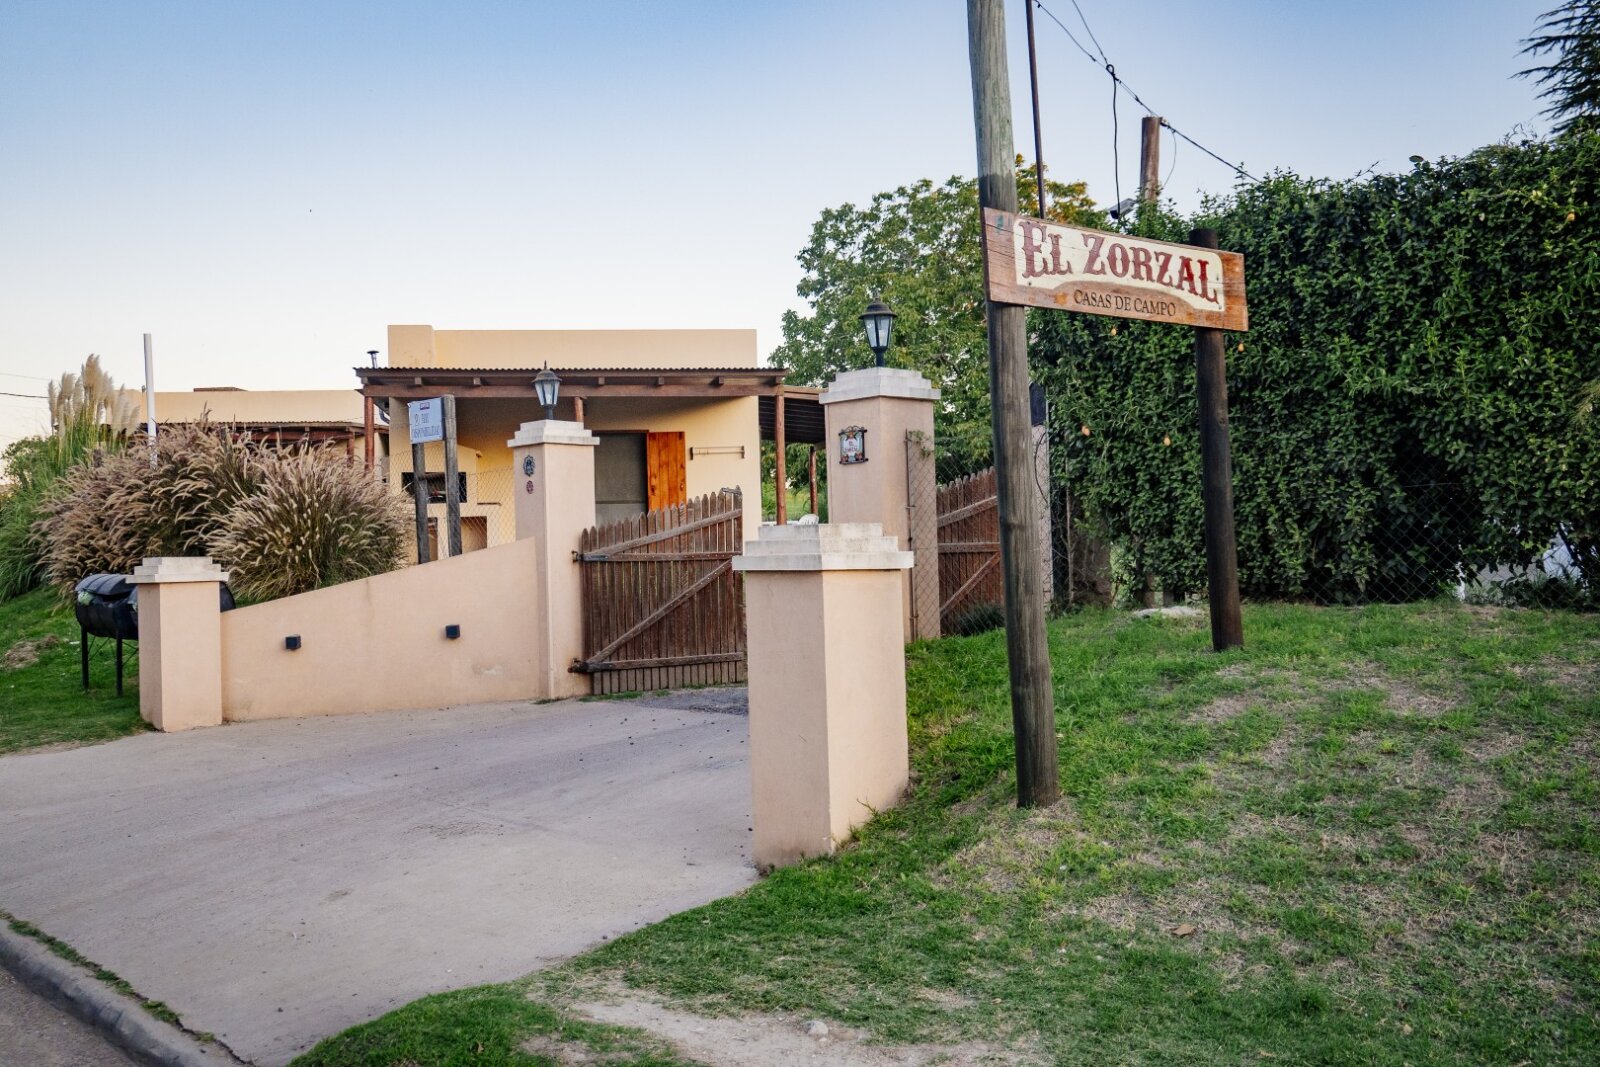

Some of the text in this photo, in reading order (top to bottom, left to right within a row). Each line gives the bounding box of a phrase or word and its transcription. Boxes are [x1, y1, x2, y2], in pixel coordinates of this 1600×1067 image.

[1019, 220, 1219, 304] EL ZORZAL
[1073, 289, 1176, 317] CASAS DE CAMPO
